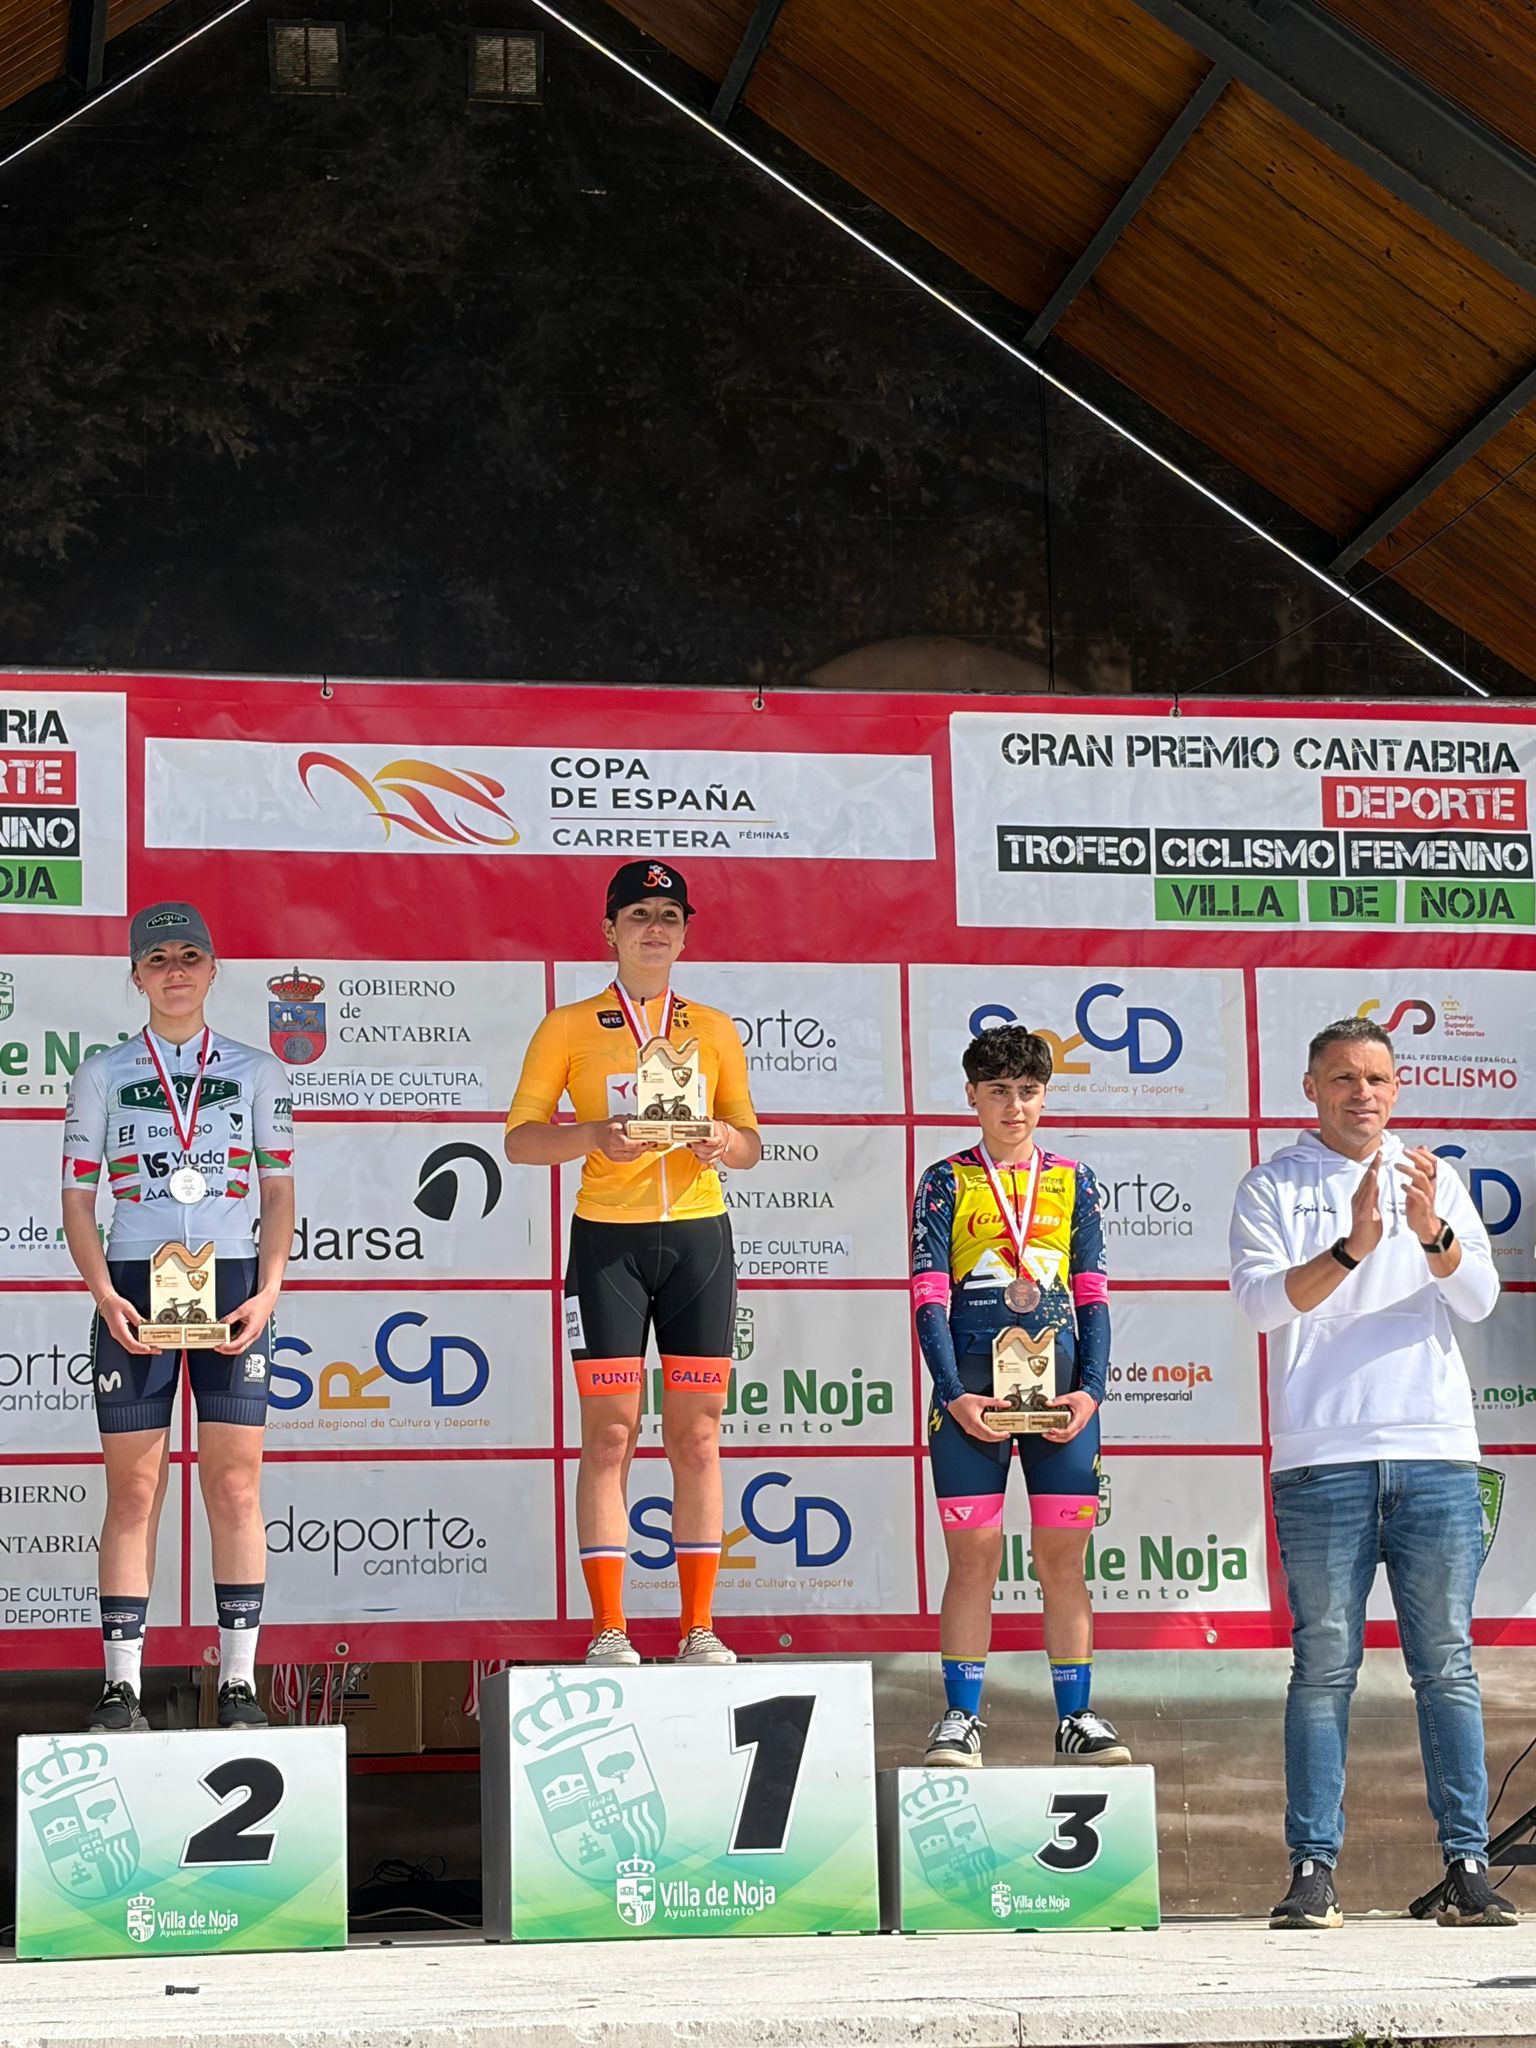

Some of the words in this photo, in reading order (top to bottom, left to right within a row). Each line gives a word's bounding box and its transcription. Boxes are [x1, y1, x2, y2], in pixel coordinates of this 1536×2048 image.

[1001, 732, 1113, 768] GRAN
[1127, 734, 1280, 769] PREMIO
[1294, 737, 1520, 773] CANTABRIA
[550, 756, 650, 779] COPA
[551, 787, 597, 809] DE
[612, 783, 756, 812] ESPAÑA
[1336, 784, 1516, 821] DEPORTE
[552, 828, 731, 848] CARRETERA
[738, 829, 790, 840] FÉMINAS
[1003, 834, 1146, 867] TROFEO
[1162, 836, 1336, 870] CICLISMO
[1350, 840, 1528, 873] FEMENINO
[1171, 883, 1284, 918] VILLA
[1330, 885, 1379, 917] DE
[1420, 887, 1515, 919] NOJA
[339, 979, 456, 997] GOBIERNO
[340, 1002, 361, 1019] de
[1444, 1014, 1473, 1022] Consejo
[339, 1026, 472, 1043] CANTABRIA
[1444, 1021, 1475, 1030] Superior
[1455, 1030, 1485, 1038] Deportes
[1420, 1054, 1473, 1062] FEDERACIÓN
[1474, 1055, 1517, 1063] ESPAÑOLA
[287, 1069, 365, 1086] NSEJERÍA
[371, 1073, 395, 1087] DE
[399, 1072, 483, 1088] CULTURA,
[1397, 1066, 1518, 1089] CICLISMO
[1090, 1083, 1128, 1093] Cultura
[1131, 1086, 1138, 1096] y
[1142, 1084, 1185, 1096] Deporte
[290, 1093, 359, 1107] URISMO
[364, 1093, 375, 1106] Y
[380, 1092, 462, 1107] DEPORTE
[723, 1191, 834, 1208] ANTABRIA
[19, 1216, 48, 1242] de
[1108, 1215, 1193, 1236] ntabria
[740, 1241, 762, 1255] DE
[768, 1241, 849, 1256] CULTURA,
[749, 1261, 828, 1275] DEPORTE
[0, 1344, 94, 1387] orte
[1126, 1362, 1148, 1382] de
[1152, 1361, 1213, 1388] noja
[592, 1371, 641, 1386] PUNTA
[671, 1370, 722, 1384] GALEA
[0, 1387, 95, 1411] antabri
[784, 1368, 893, 1427] Noja
[1124, 1389, 1193, 1403] empresarial
[265, 1417, 315, 1429] ociedad
[318, 1417, 368, 1431] Regional
[371, 1417, 385, 1428] de
[389, 1417, 431, 1428] Cultura
[434, 1420, 440, 1431] y
[444, 1417, 491, 1430] Deporte
[363, 1552, 487, 1576] cantabria
[1140, 1533, 1247, 1592] Noja
[737, 1578, 752, 1588] de
[755, 1578, 797, 1588] Cultura
[799, 1581, 805, 1590] y
[808, 1578, 854, 1590] Deporte
[27, 1586, 98, 1602] CULTUR
[5, 1608, 92, 1624] DEPORTE
[731, 1693, 818, 1852] 1
[181, 1756, 286, 1866] 2
[1036, 1793, 1109, 1871] 3
[660, 1880, 700, 1907] Villa
[705, 1880, 729, 1906] de
[734, 1879, 776, 1911] Noja
[1012, 1894, 1033, 1909] Villa
[1035, 1894, 1047, 1909] de
[1048, 1894, 1071, 1911] Noja
[157, 1910, 186, 1929] Villa
[188, 1909, 206, 1929] de
[208, 1908, 239, 1932] Noja
[664, 1906, 754, 1920] Ayuntamiento
[160, 1927, 224, 1938] Ayuntamiento
